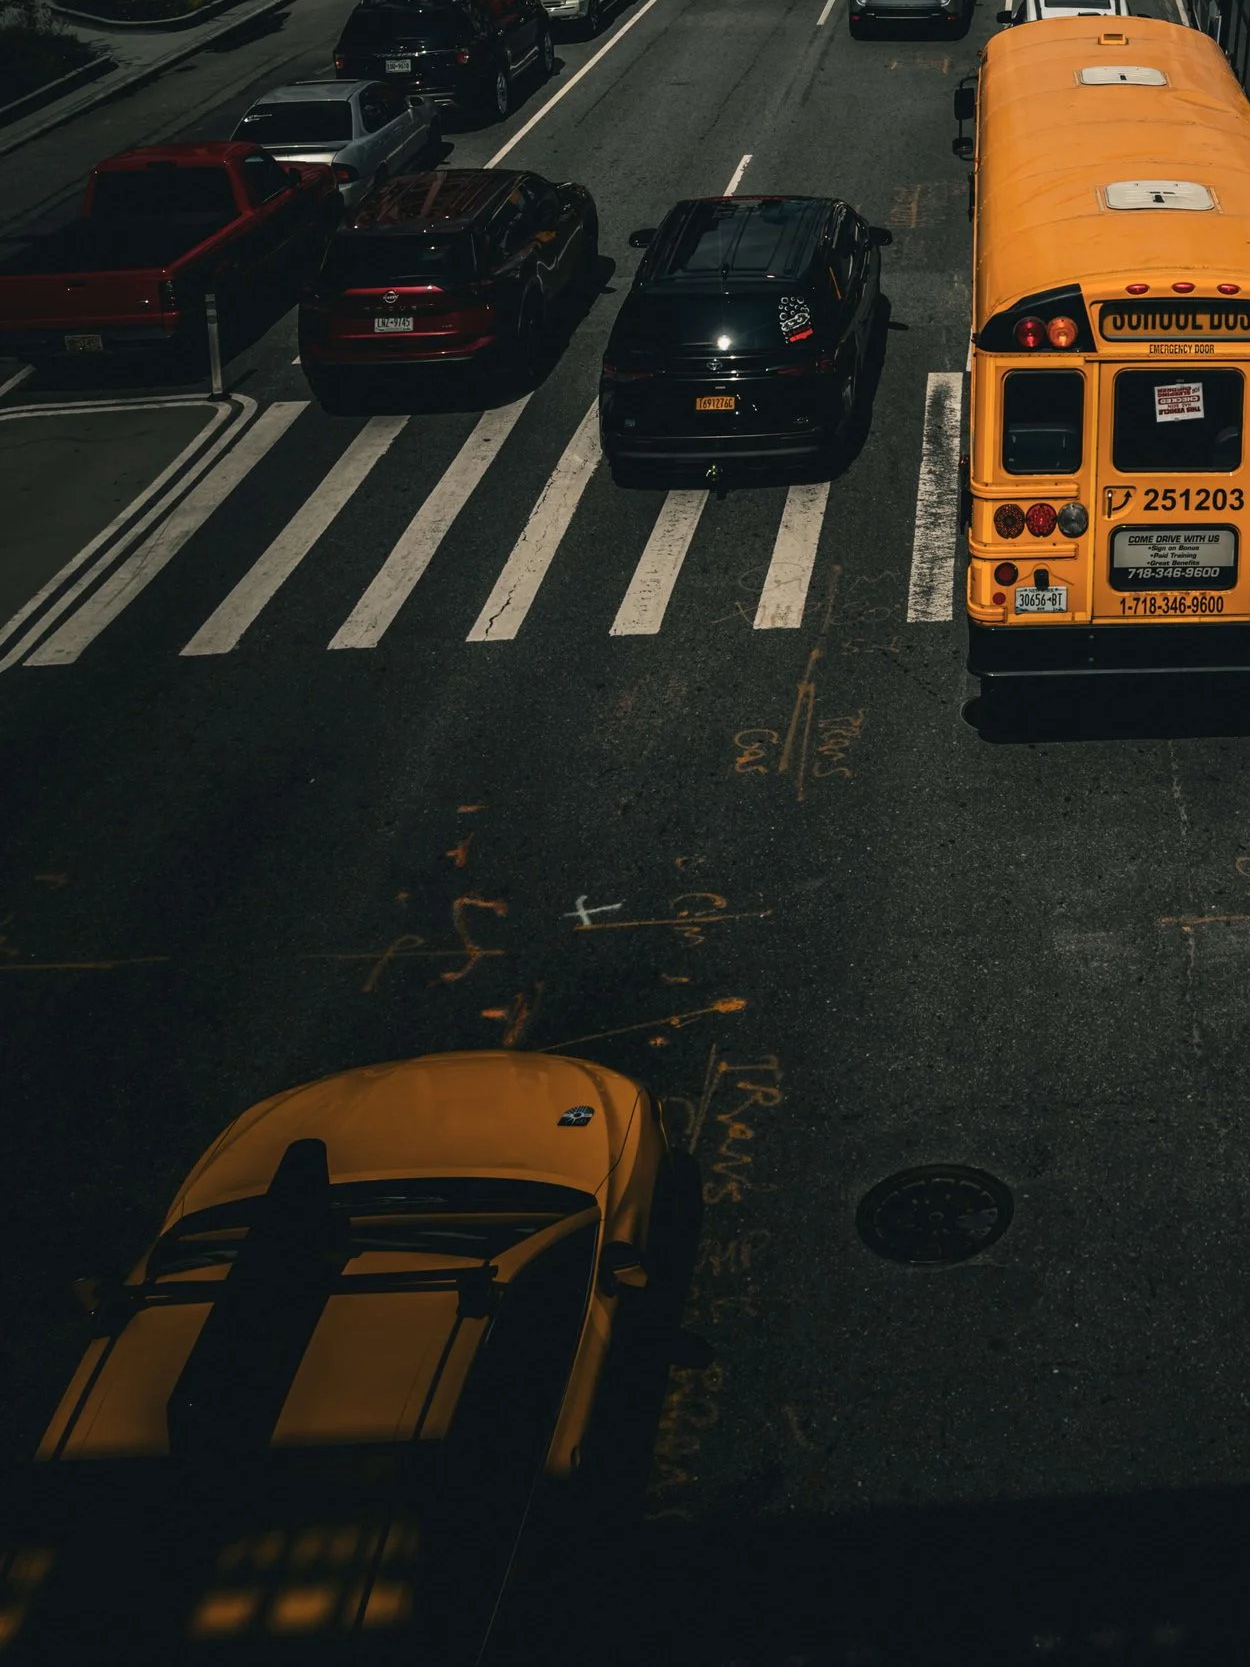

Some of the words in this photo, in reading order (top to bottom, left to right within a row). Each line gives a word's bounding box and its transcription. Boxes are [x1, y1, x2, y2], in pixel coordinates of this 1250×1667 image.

[1150, 344, 1193, 354] EMERGENCY
[1195, 344, 1214, 354] DOOR
[1160, 396, 1199, 404] CHECKED
[1143, 488, 1245, 511] 251203
[1128, 535, 1153, 543] COME
[1156, 535, 1181, 543] DRIVE
[1184, 535, 1206, 543] WITH
[1208, 534, 1220, 542] US
[1127, 567, 1221, 579] 718-346-9600
[1119, 595, 1225, 615] 1-718-346-9600
